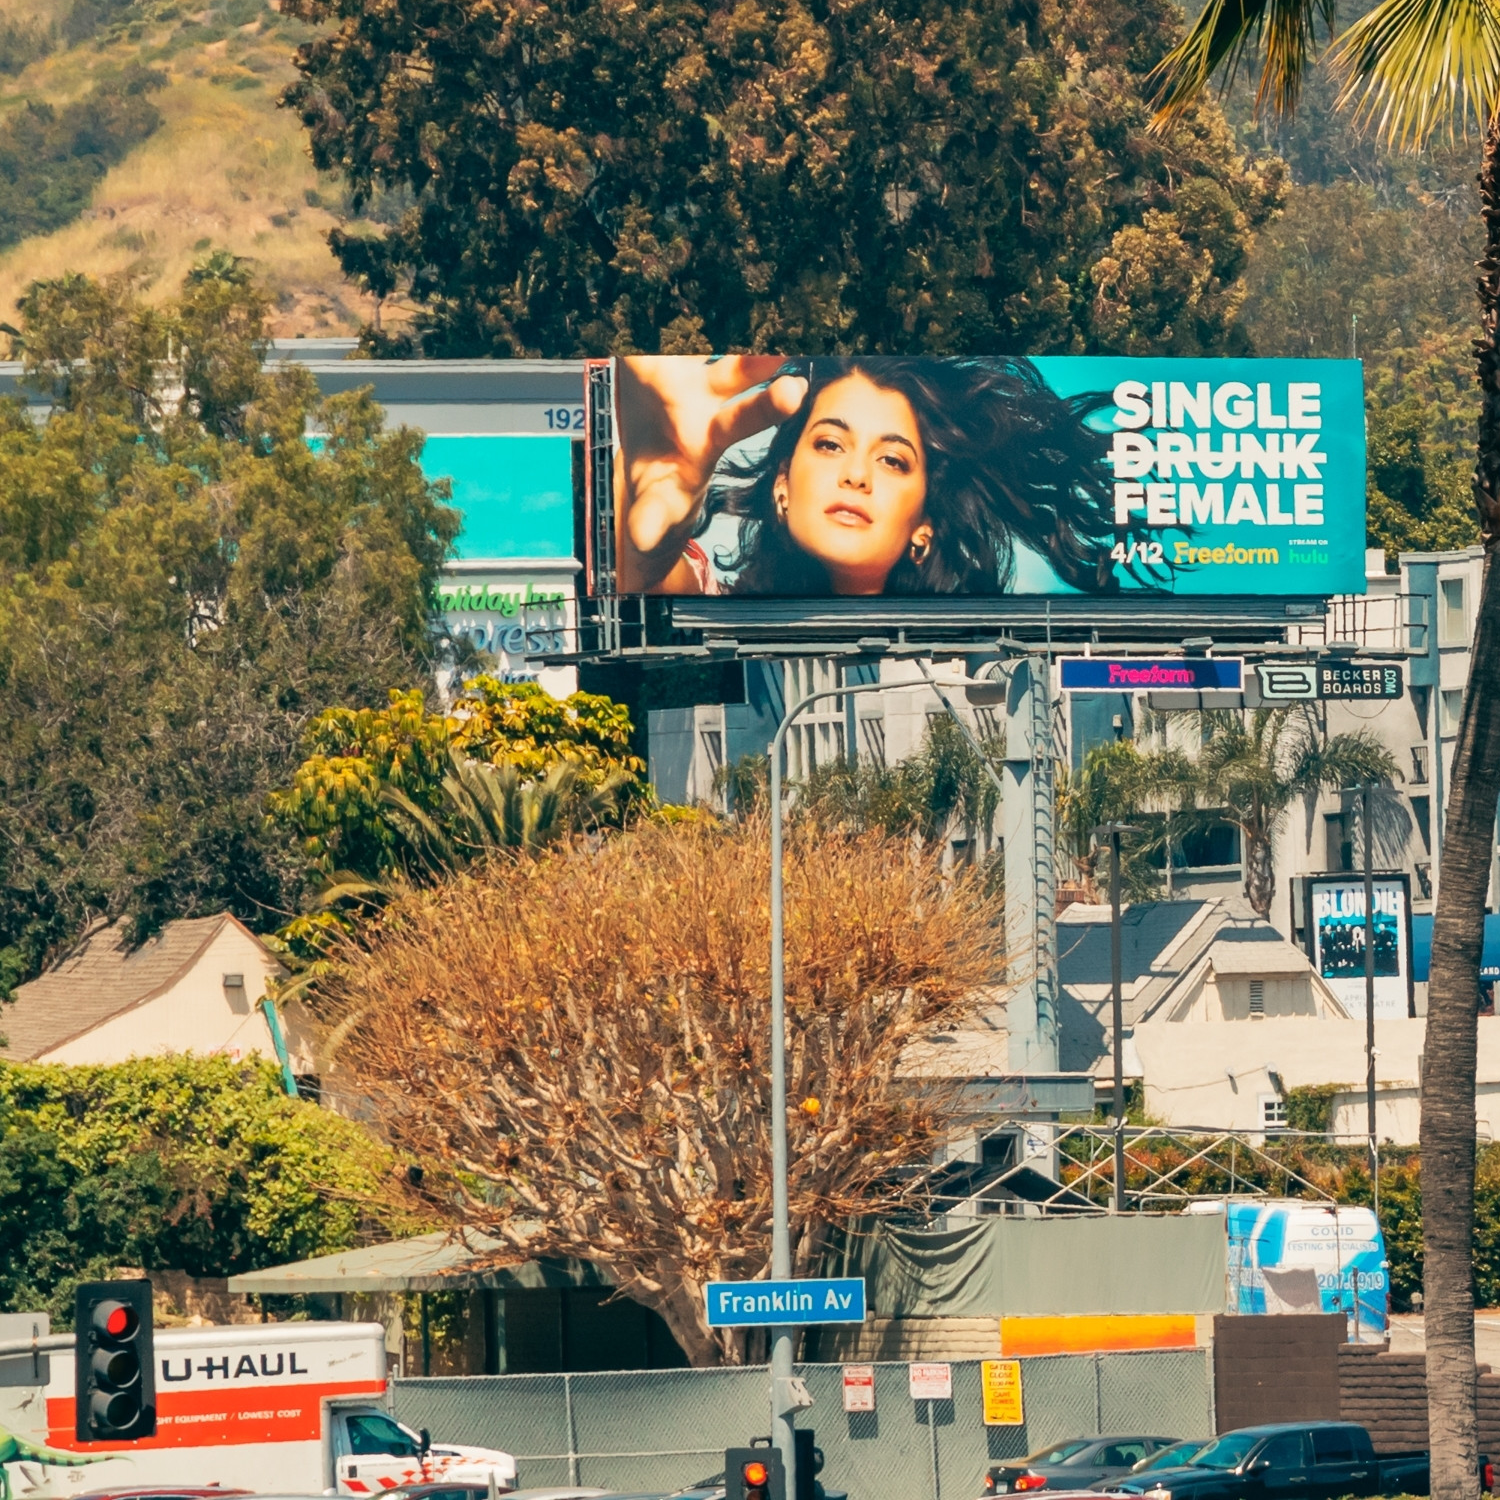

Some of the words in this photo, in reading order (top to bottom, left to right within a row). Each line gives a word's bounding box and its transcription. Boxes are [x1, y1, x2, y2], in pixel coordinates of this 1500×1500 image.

[1112, 380, 1322, 429] SINGLE
[1110, 432, 1325, 479] DRUNK
[1113, 483, 1325, 525] FEMALE
[1110, 542, 1163, 564] 4/12
[1173, 542, 1279, 565] Freeform
[1289, 549, 1329, 565] hulu
[525, 581, 566, 611] Inn
[445, 622, 565, 655] press
[1108, 665, 1196, 684] Freeform
[1322, 669, 1381, 681] BECKER
[1322, 683, 1381, 694] BOARDS
[1311, 1227, 1354, 1236] COVID
[1288, 1243, 1323, 1251] TESTING
[719, 1290, 813, 1314] Franklin
[823, 1289, 852, 1311] Av
[162, 1352, 309, 1382] U-HAUL
[156, 1416, 173, 1425] GHT
[174, 1412, 228, 1424] EQUIPMENT
[237, 1410, 274, 1420] LOWEST
[277, 1409, 302, 1418] COST
